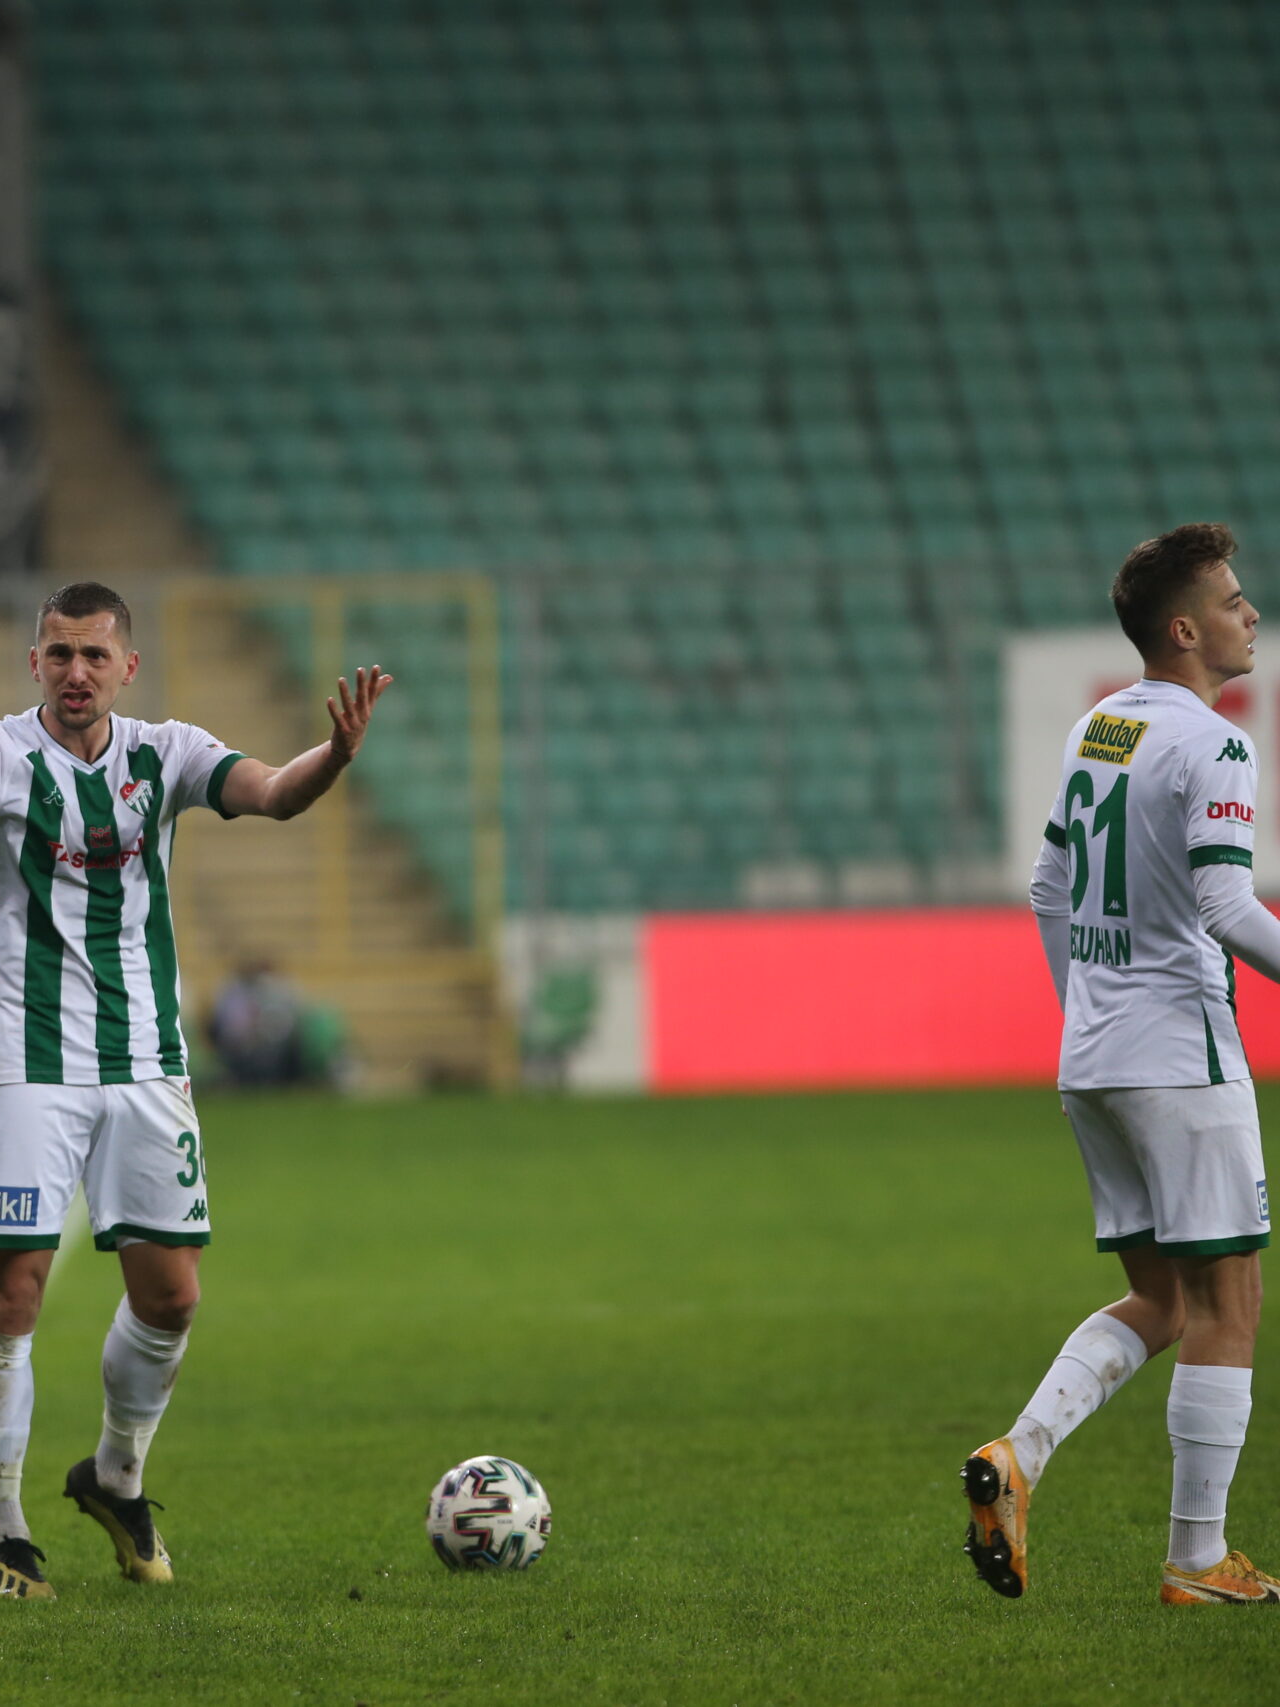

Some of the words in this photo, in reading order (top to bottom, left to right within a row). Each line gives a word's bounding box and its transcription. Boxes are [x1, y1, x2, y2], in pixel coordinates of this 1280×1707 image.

[1083, 715, 1145, 755] uludağ
[1065, 769, 1130, 918] 61
[1070, 923, 1131, 966] BUHAN
[176, 1131, 206, 1188] 3
